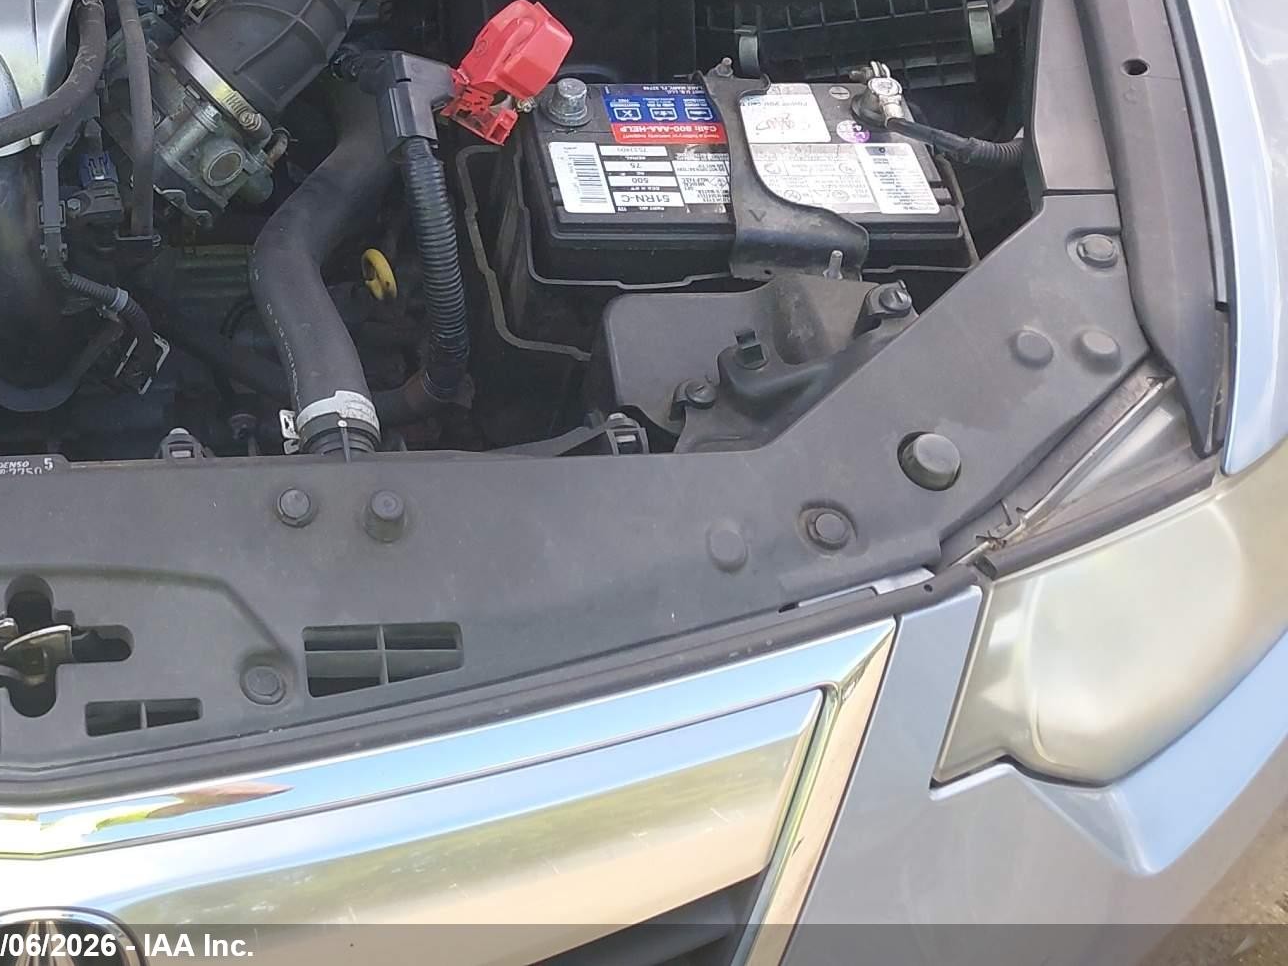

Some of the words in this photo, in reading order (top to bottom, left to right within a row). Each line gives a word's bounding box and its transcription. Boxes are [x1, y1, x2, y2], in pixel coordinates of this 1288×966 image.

[619, 125, 693, 133] 800-AAA-HELP
[694, 125, 717, 133] Call:
[620, 194, 671, 203] 51RN-C
[43, 457, 54, 471] 5
